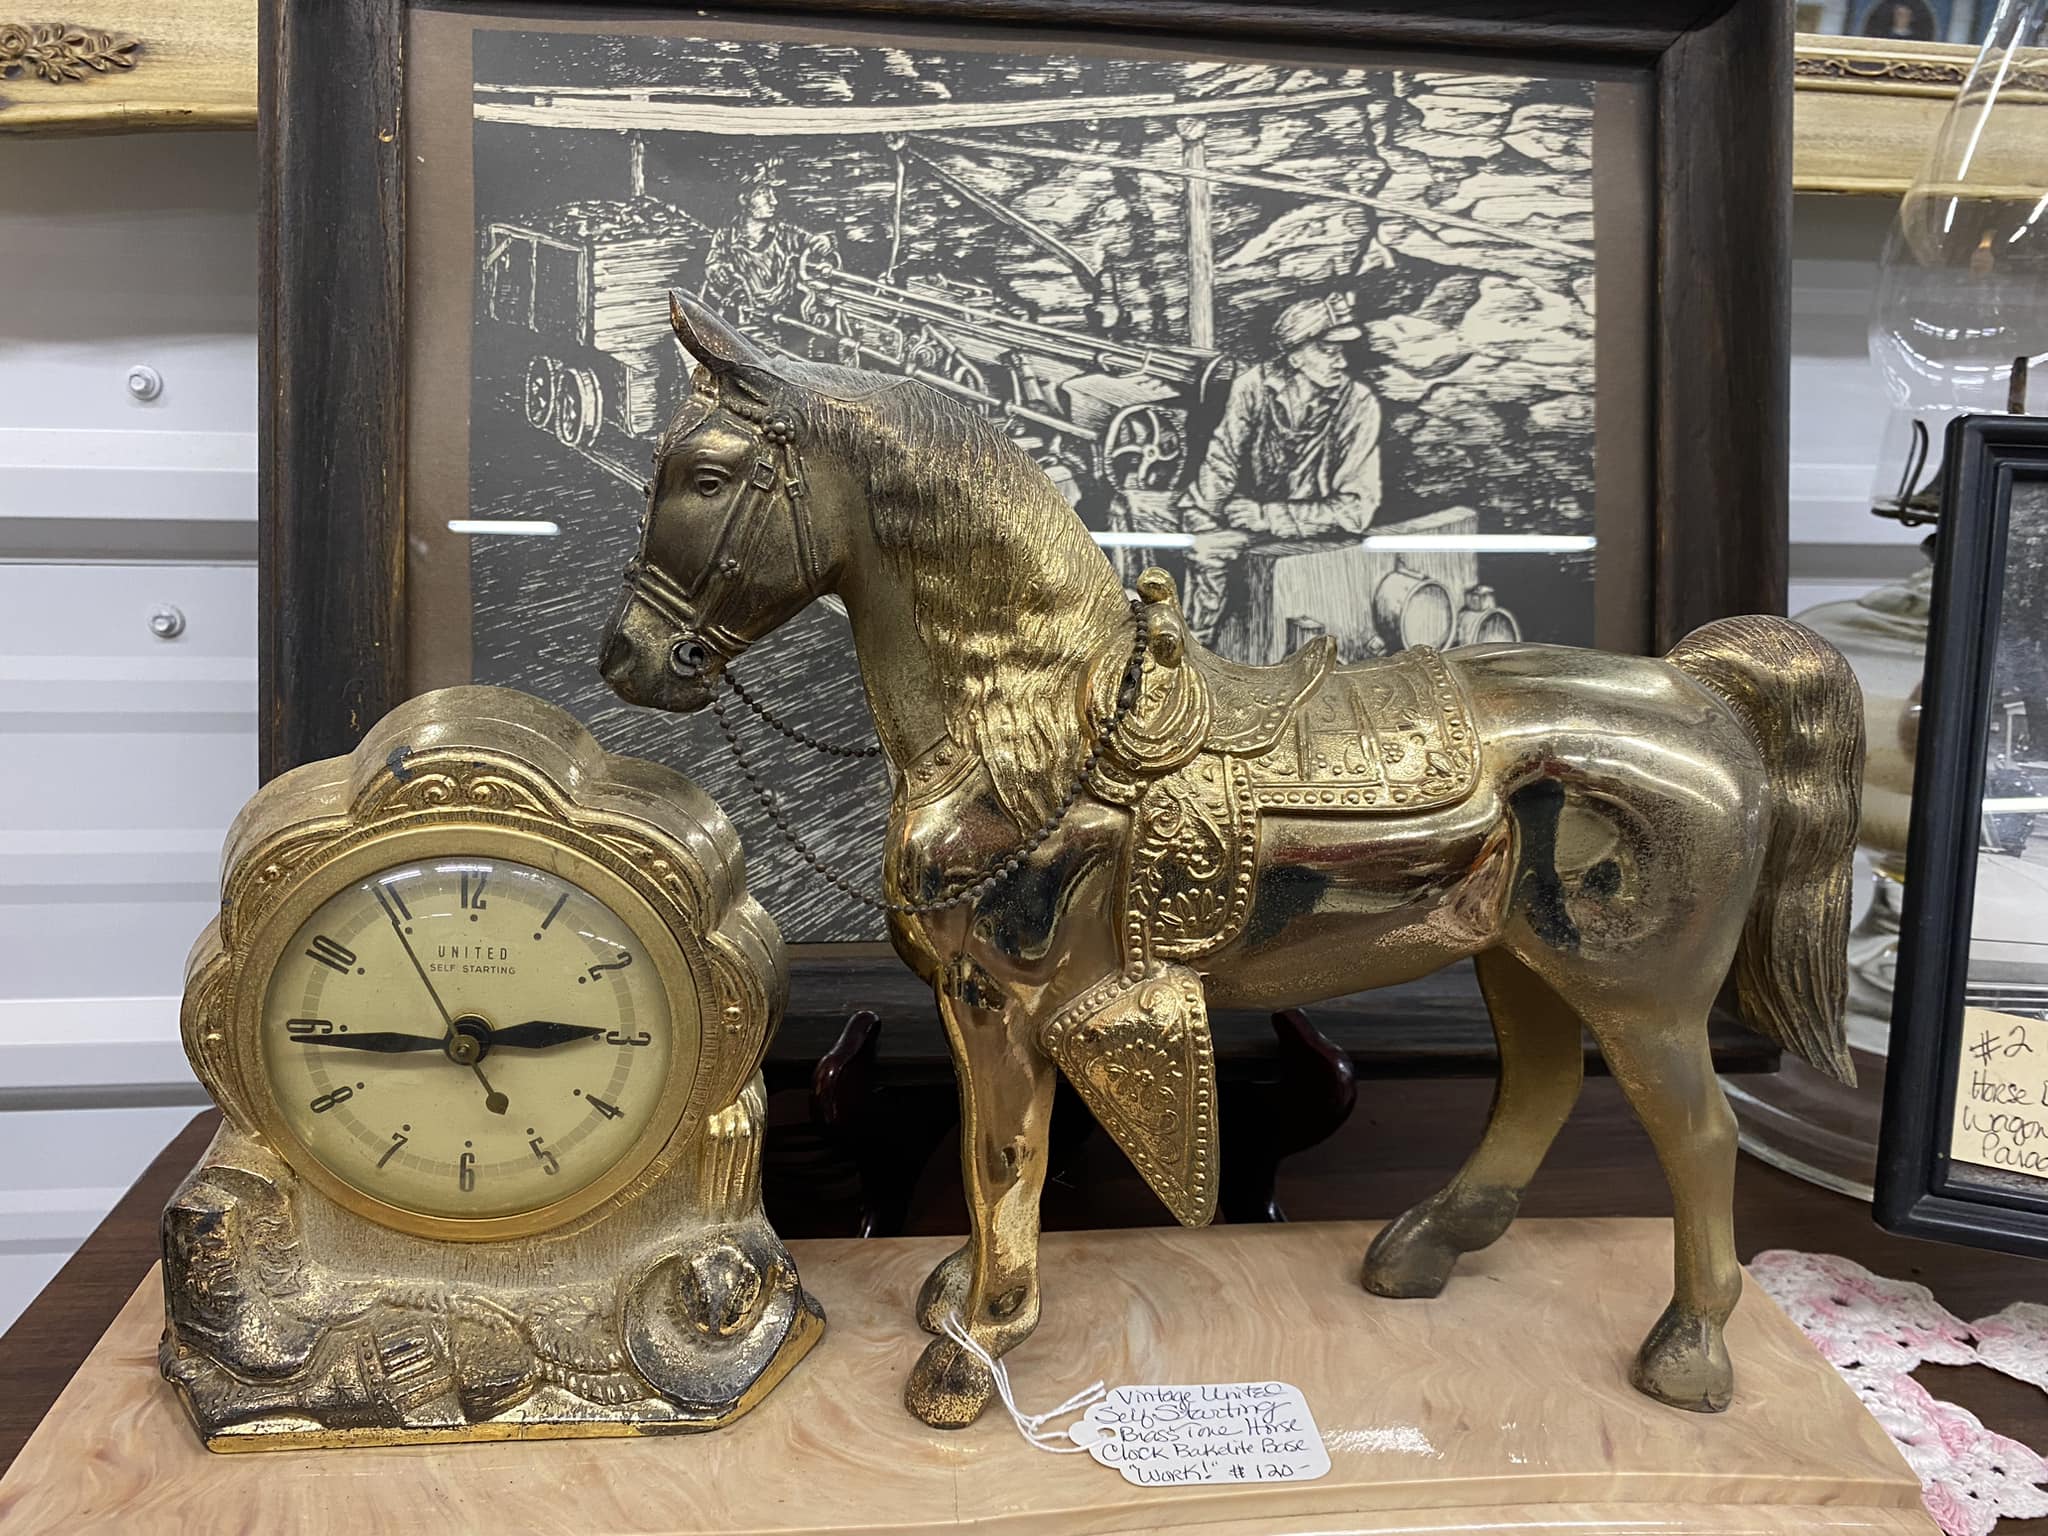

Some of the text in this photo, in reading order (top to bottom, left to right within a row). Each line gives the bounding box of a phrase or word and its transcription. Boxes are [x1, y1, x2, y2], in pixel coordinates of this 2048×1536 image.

[461, 869, 488, 910] 12
[541, 893, 570, 930] 1
[305, 934, 357, 975] 10
[438, 945, 508, 960] UNITED
[588, 951, 632, 981] 2
[430, 963, 516, 975] SELF STARTING
[286, 1018, 333, 1035] 9
[606, 1031, 651, 1046] 3
[1969, 1025, 2034, 1066] #2
[310, 1085, 354, 1114] 8
[585, 1093, 625, 1121] 4
[376, 1132, 409, 1169] 7
[528, 1139, 560, 1175] 5
[459, 1152, 475, 1192] 6
[1116, 1386, 1192, 1413] Vintage
[1120, 1426, 1180, 1442] Brass
[1244, 1417, 1303, 1436] Horse
[1262, 1438, 1310, 1453] Base
